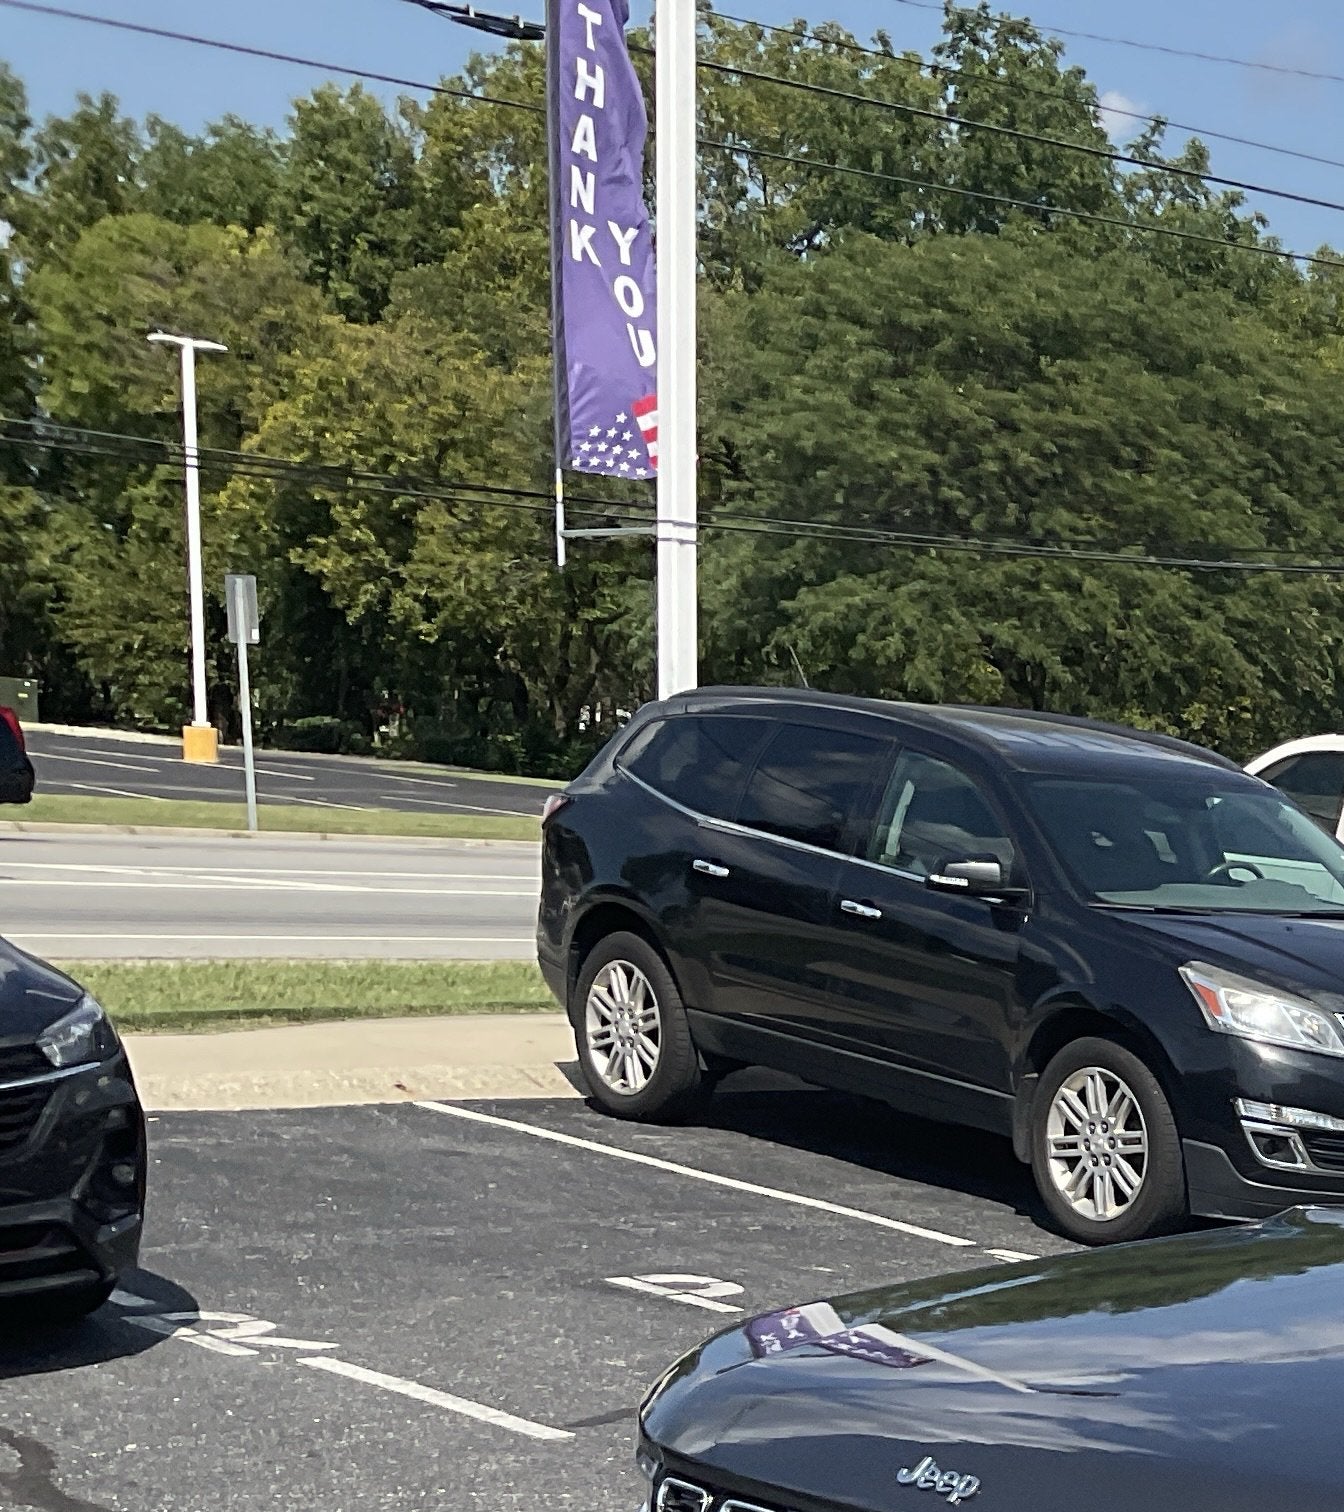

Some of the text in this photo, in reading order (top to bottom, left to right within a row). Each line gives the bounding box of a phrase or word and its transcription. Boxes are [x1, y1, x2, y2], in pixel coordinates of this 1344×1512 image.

[570, 3, 656, 368] THANK YOU
[896, 1456, 982, 1506] Jeep
